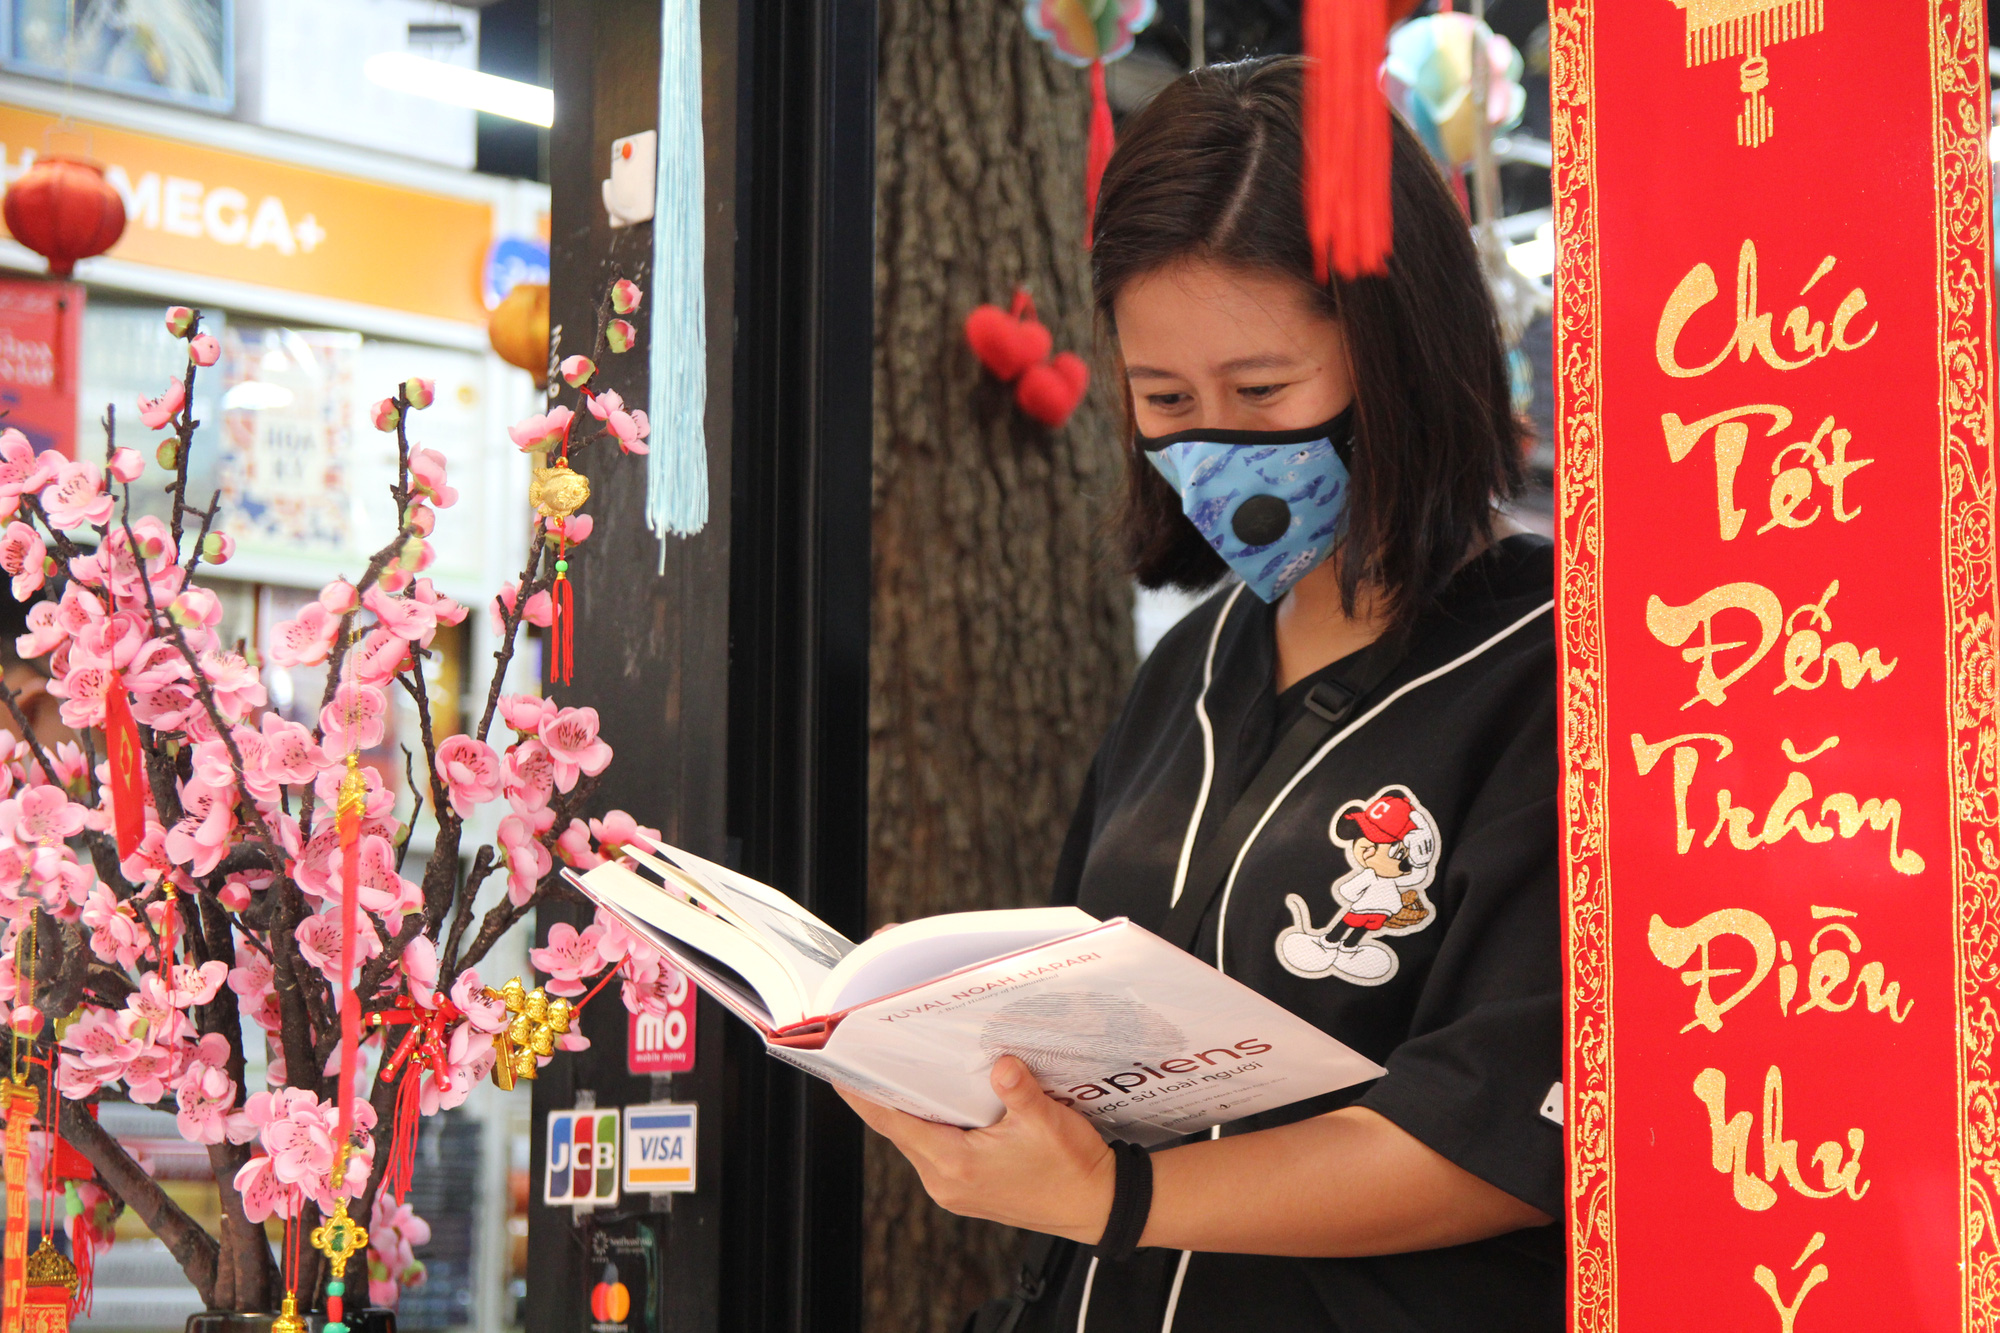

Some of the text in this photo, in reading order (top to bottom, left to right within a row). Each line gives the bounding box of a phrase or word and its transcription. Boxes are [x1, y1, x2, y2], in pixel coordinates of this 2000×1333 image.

[1656, 239, 1878, 378] Chúc
[1661, 404, 1874, 541] Tết
[1646, 579, 1898, 711] Đến
[1370, 801, 1391, 819] C
[1631, 733, 1925, 876] Trăm
[879, 952, 1102, 1023] YUVAL NOAH HARARI
[945, 1001, 967, 1014] Brief
[968, 990, 999, 1006] History
[1010, 973, 1059, 992] Humankind
[636, 1052, 687, 1063] mobile money
[1131, 1089, 1157, 1103] sử
[1159, 1077, 1199, 1094] loài
[1201, 1060, 1264, 1083] người
[550, 1135, 684, 1173] JCB VISA
[1693, 1065, 1870, 1211] Như
[1753, 1232, 1828, 1333] Ý
